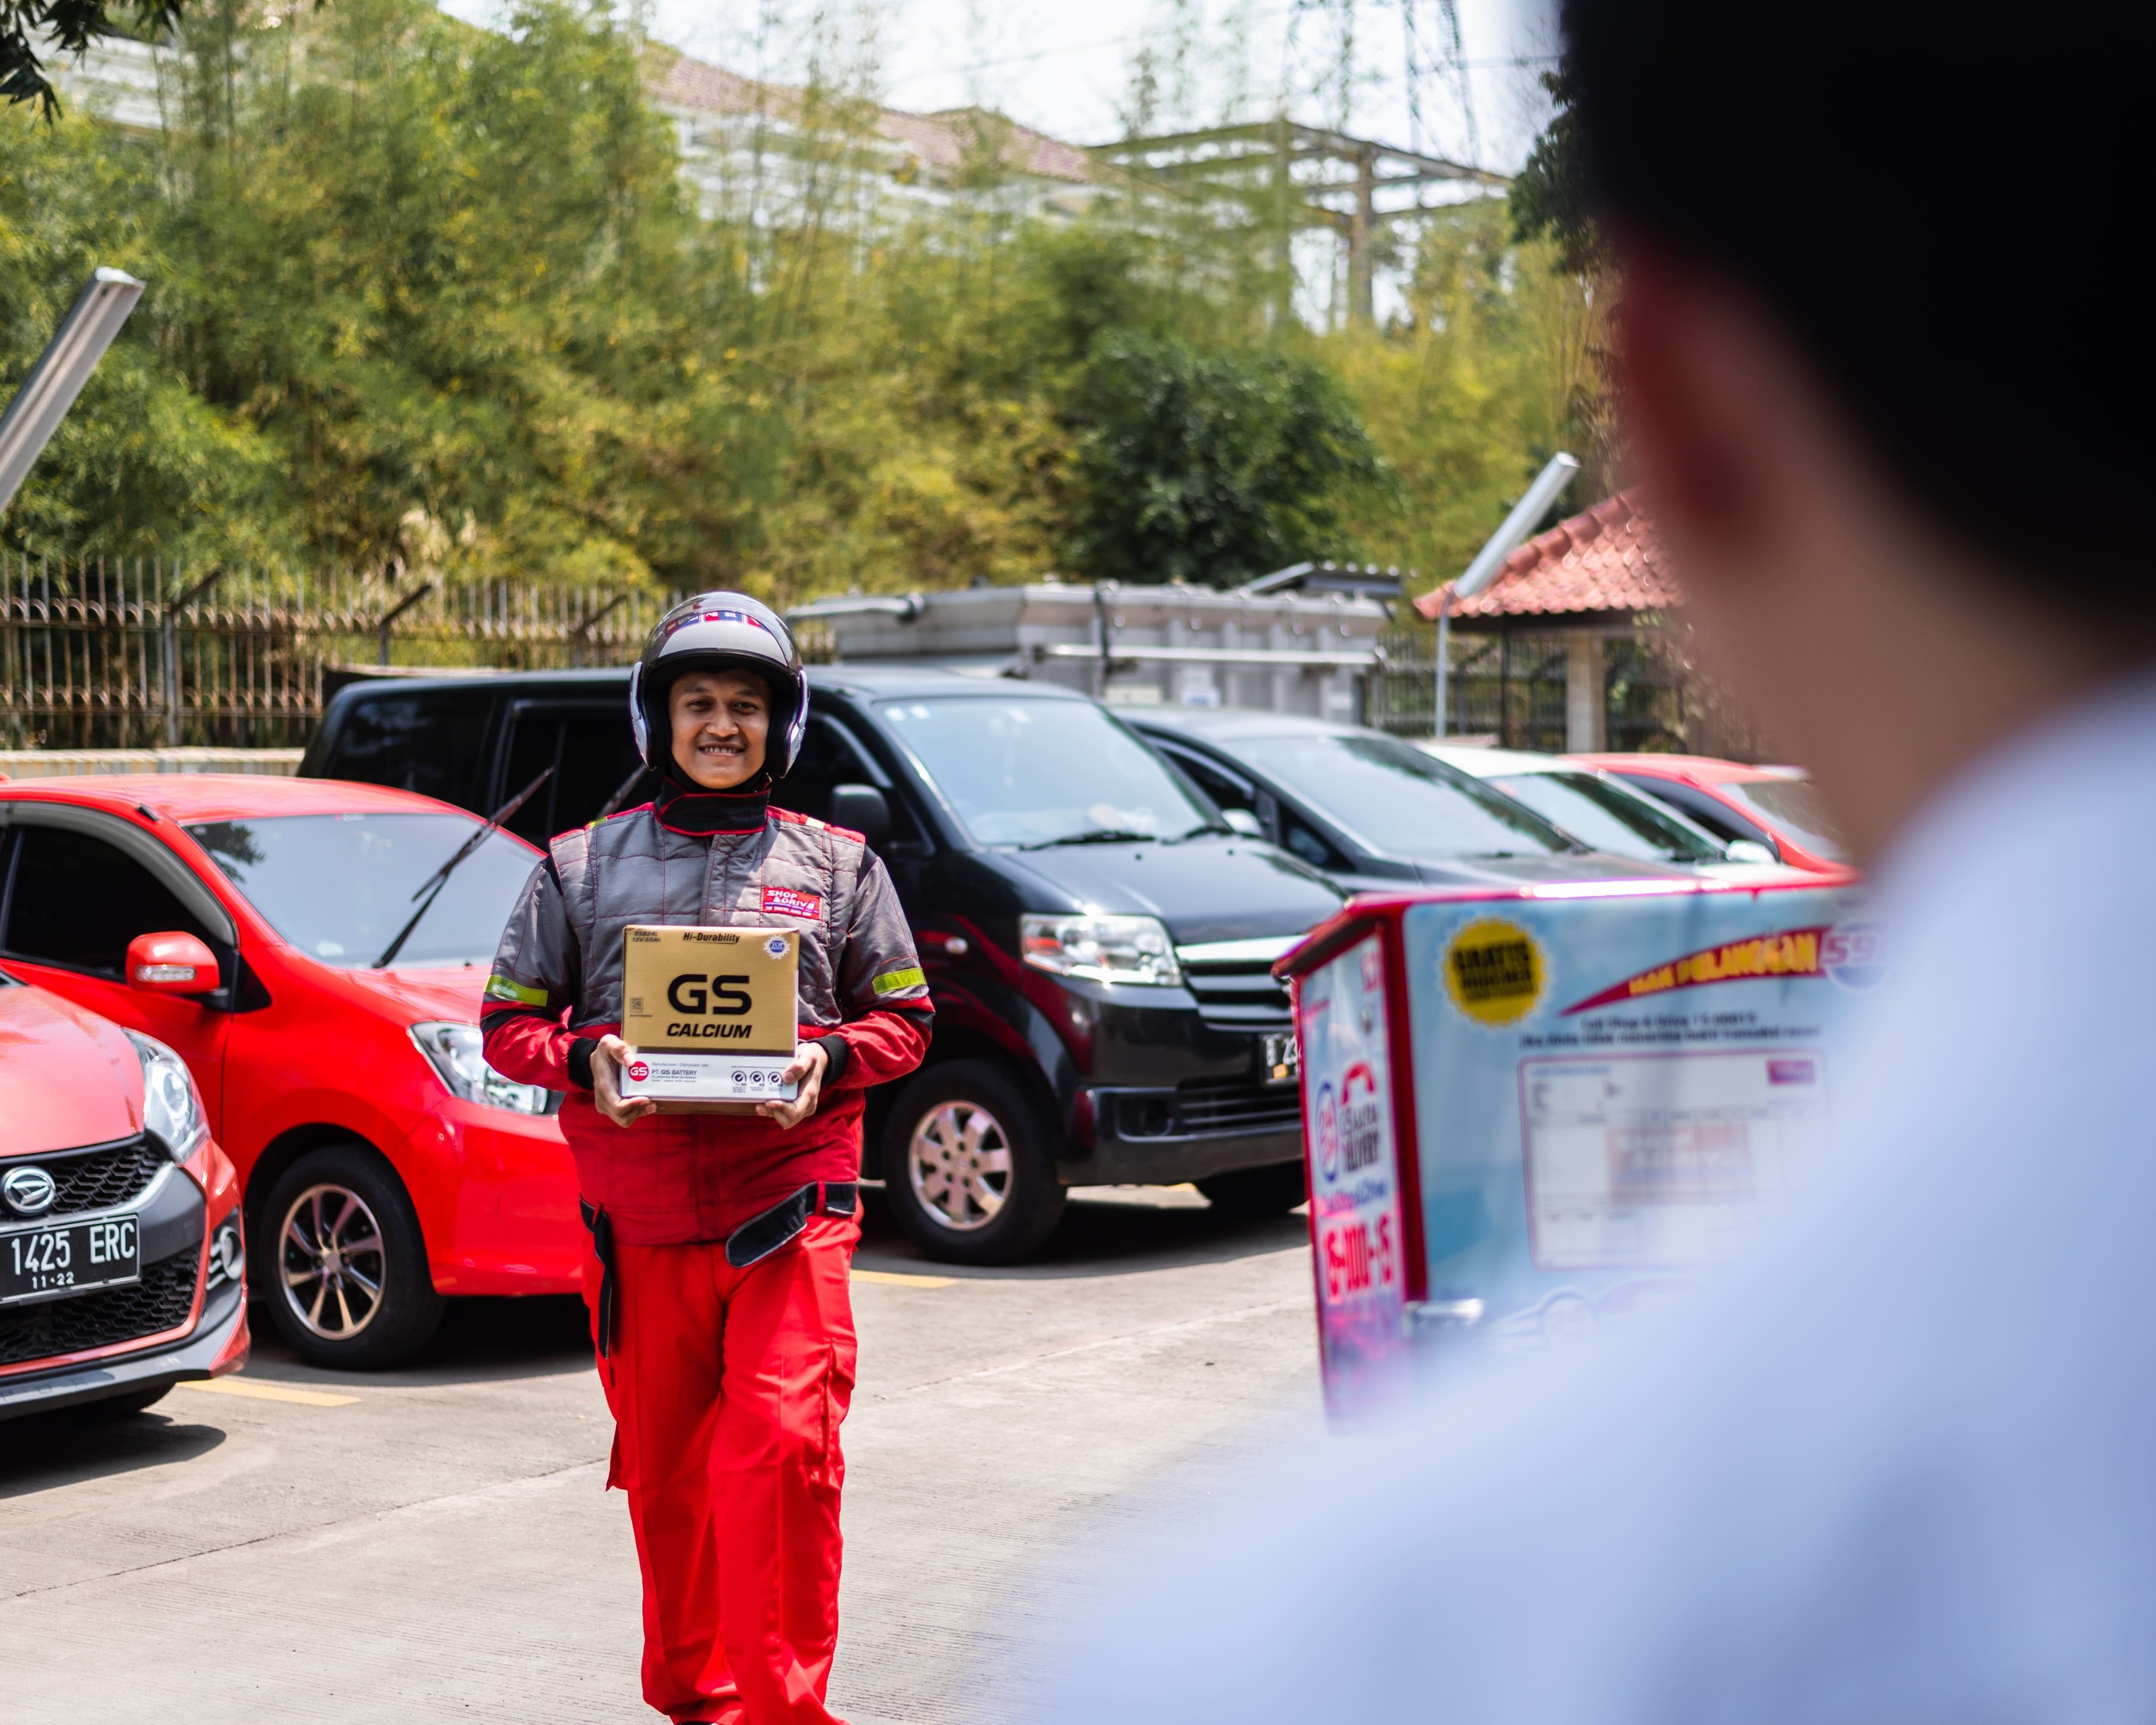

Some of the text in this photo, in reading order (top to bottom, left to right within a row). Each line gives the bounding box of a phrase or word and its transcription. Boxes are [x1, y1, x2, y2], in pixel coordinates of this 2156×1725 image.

[767, 890, 798, 899] SHOP
[683, 932, 740, 943] Hi-Durability
[667, 974, 752, 1015] GS
[667, 1022, 752, 1039] CALCIUM
[630, 1067, 648, 1076] GS
[11, 1222, 136, 1275] 1425 ERC
